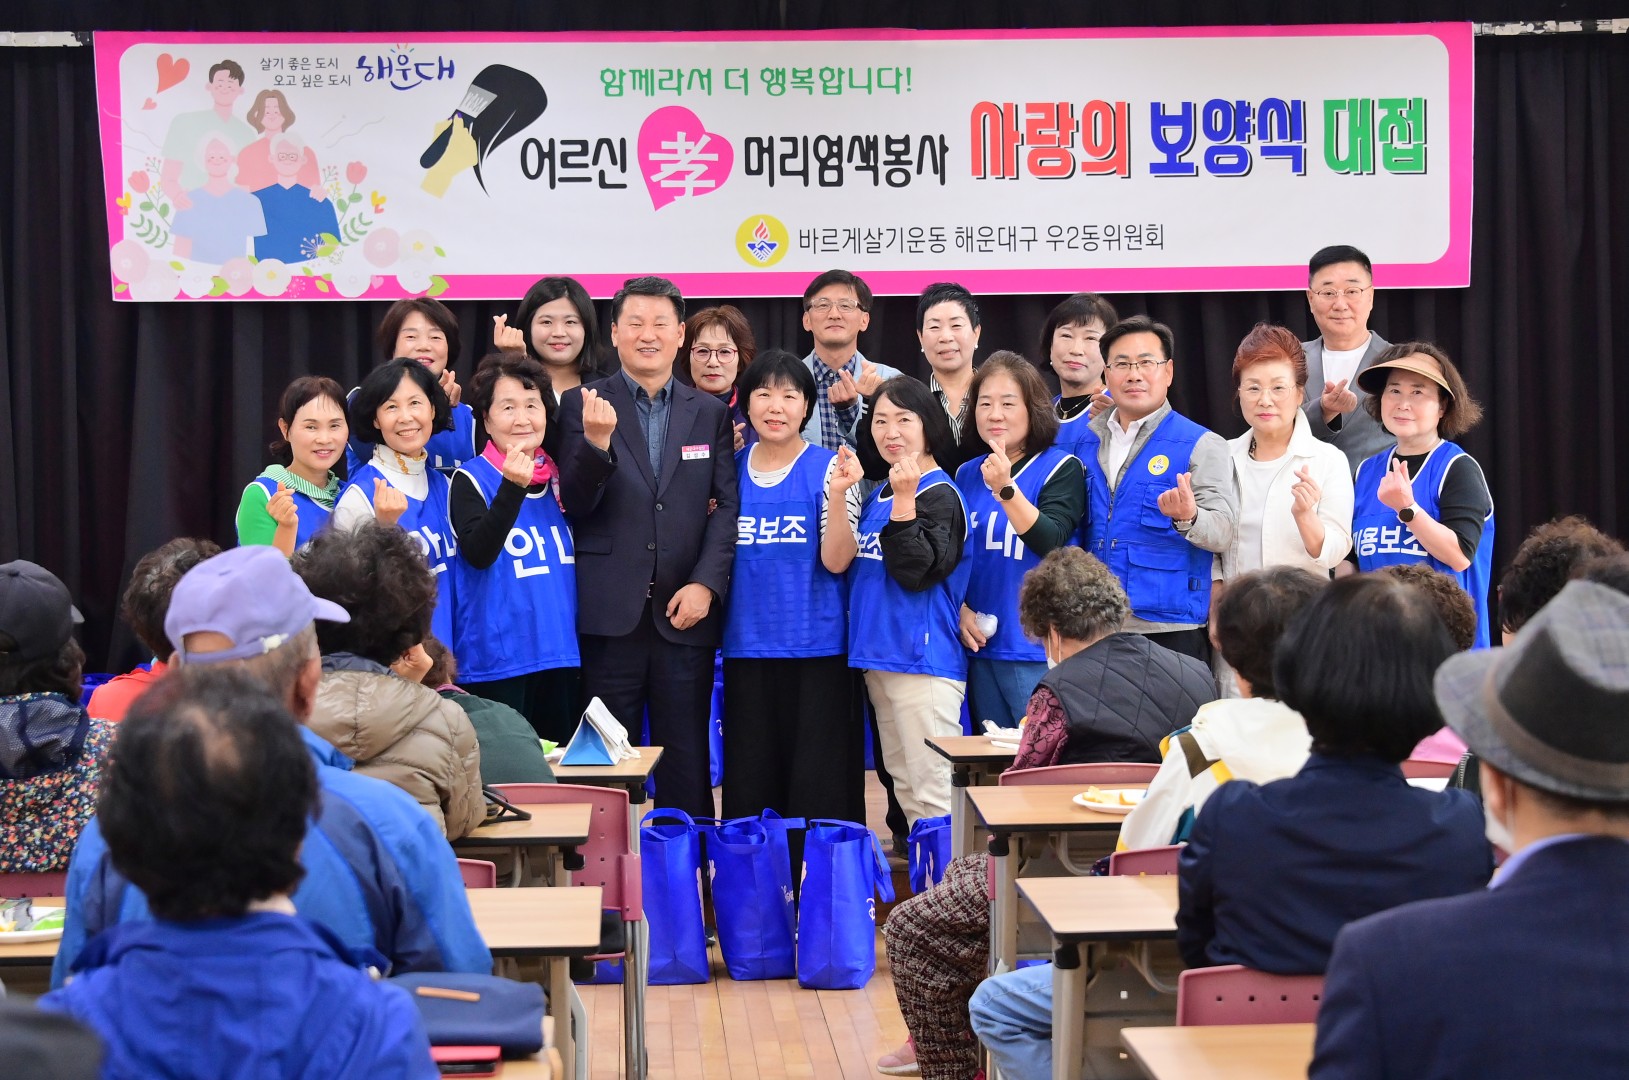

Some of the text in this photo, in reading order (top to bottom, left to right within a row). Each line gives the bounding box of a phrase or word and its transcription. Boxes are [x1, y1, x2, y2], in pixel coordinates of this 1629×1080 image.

[260, 57, 339, 71] 살기 좋은 도시
[356, 54, 455, 91] 해운대
[273, 74, 351, 88] 오고 싶은 도시
[600, 66, 912, 97] 함께라서 더 행복합니다!
[520, 97, 1428, 199] 어르신 孝 머리염색봉사 사랑의 보양식 대접
[799, 223, 1164, 254] 바르게살기운동 해운대구 우2동위원회
[735, 516, 808, 546] 용보조
